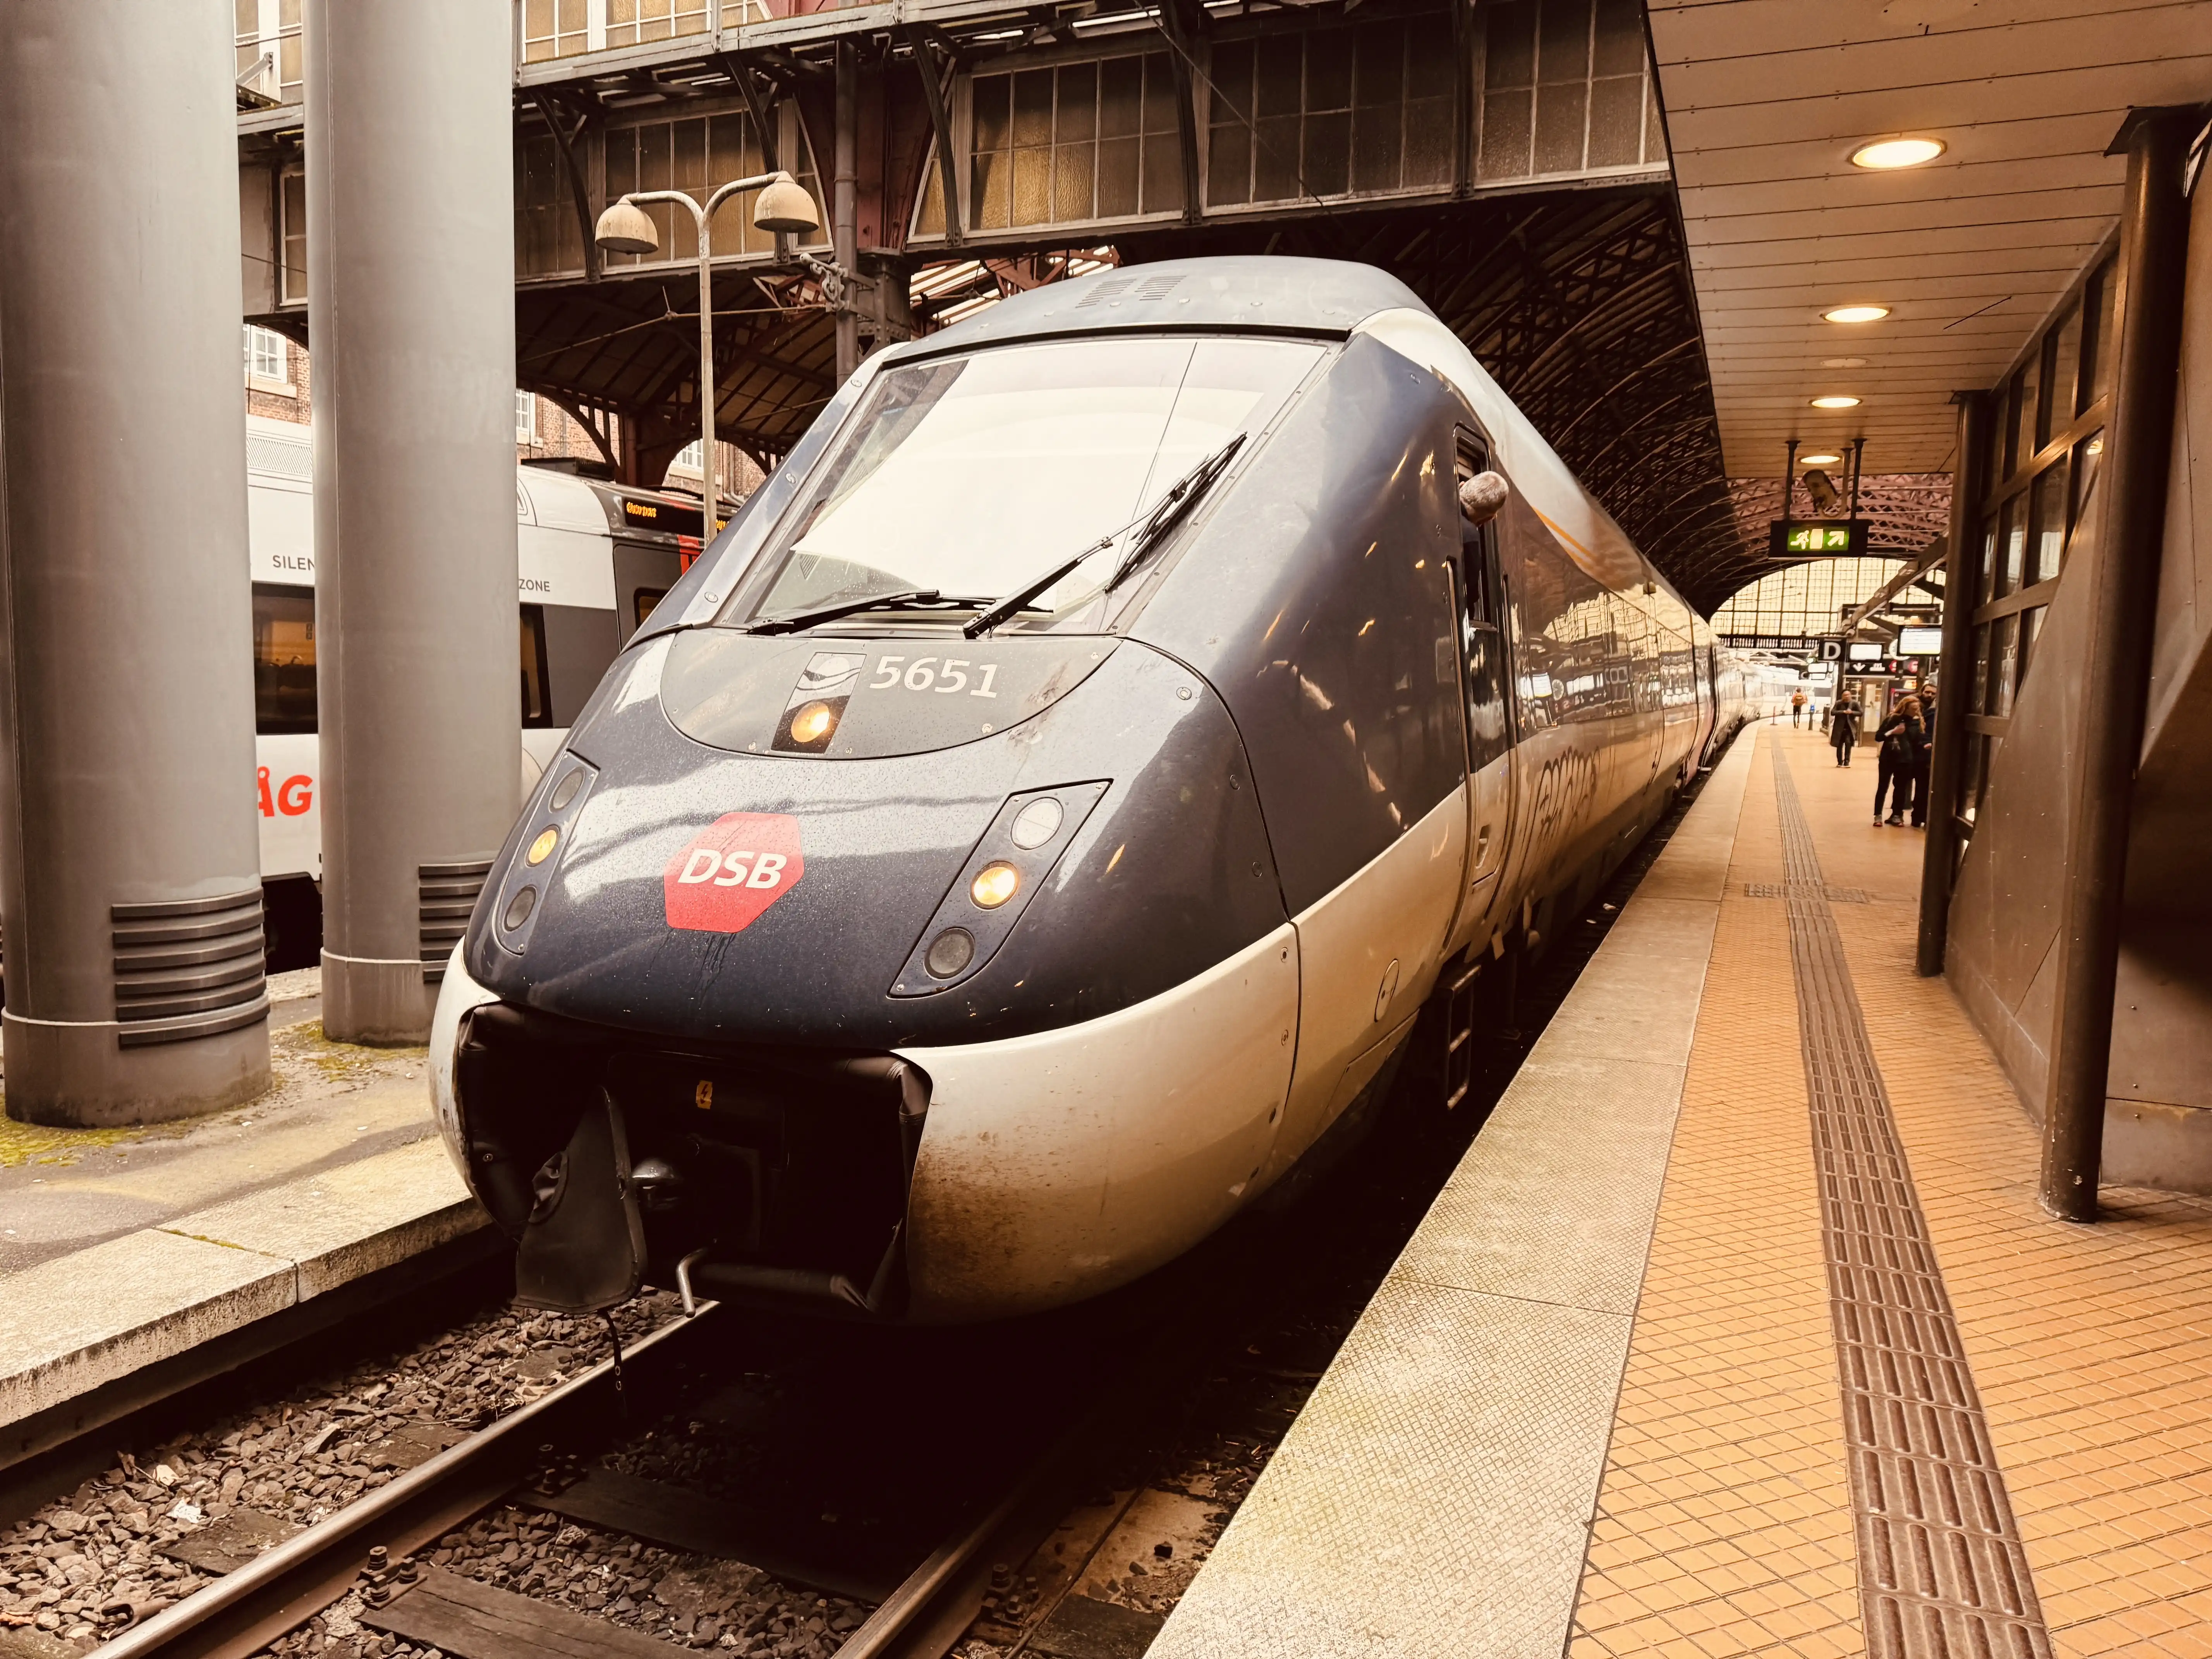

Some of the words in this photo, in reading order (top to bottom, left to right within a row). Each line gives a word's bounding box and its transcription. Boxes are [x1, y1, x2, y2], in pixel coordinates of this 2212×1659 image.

[519, 579, 550, 592] ZONE
[1824, 642, 1841, 660] D
[869, 656, 998, 698] 5651
[678, 848, 787, 889] DSB
